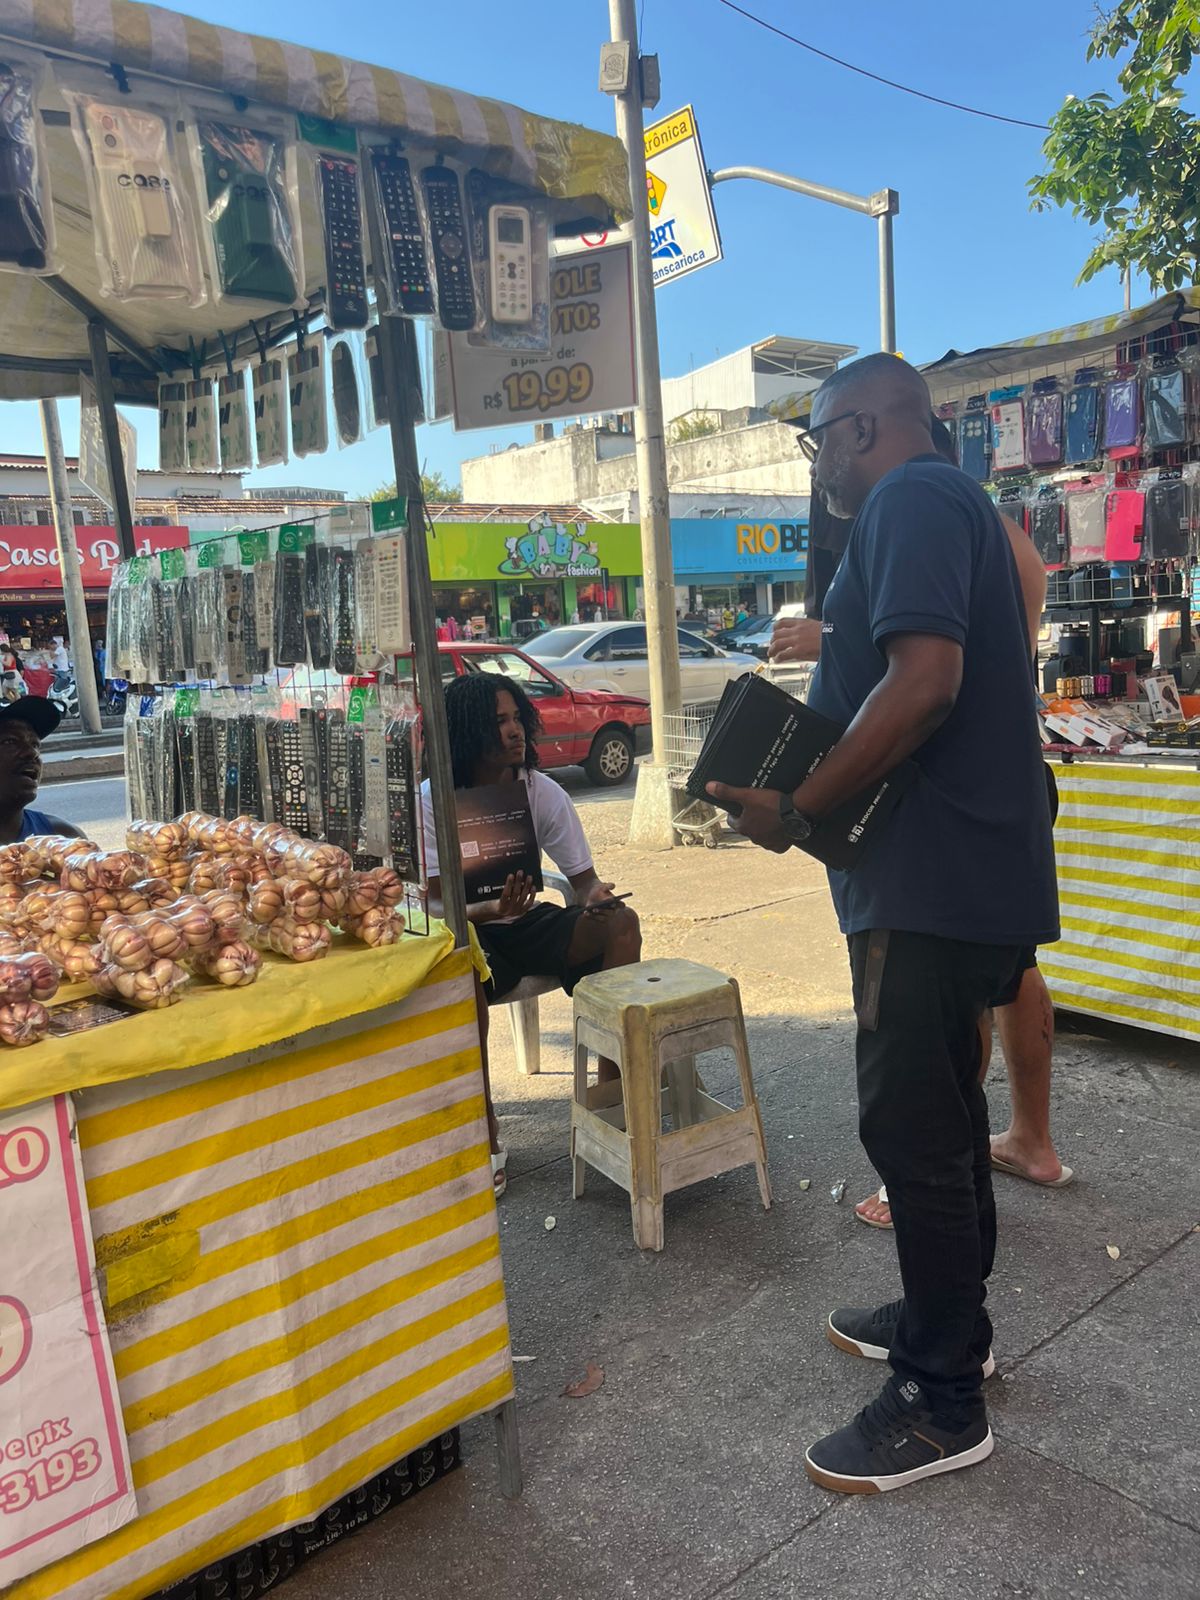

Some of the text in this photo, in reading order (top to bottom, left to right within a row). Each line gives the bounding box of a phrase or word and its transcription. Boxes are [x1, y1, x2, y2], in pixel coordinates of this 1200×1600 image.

[650, 218, 675, 251] BRT
[557, 347, 575, 360] de:
[484, 362, 593, 412] R$ 19,99
[519, 533, 587, 564] BABY
[567, 562, 600, 576] fashion
[5, 1417, 72, 1460] e pix
